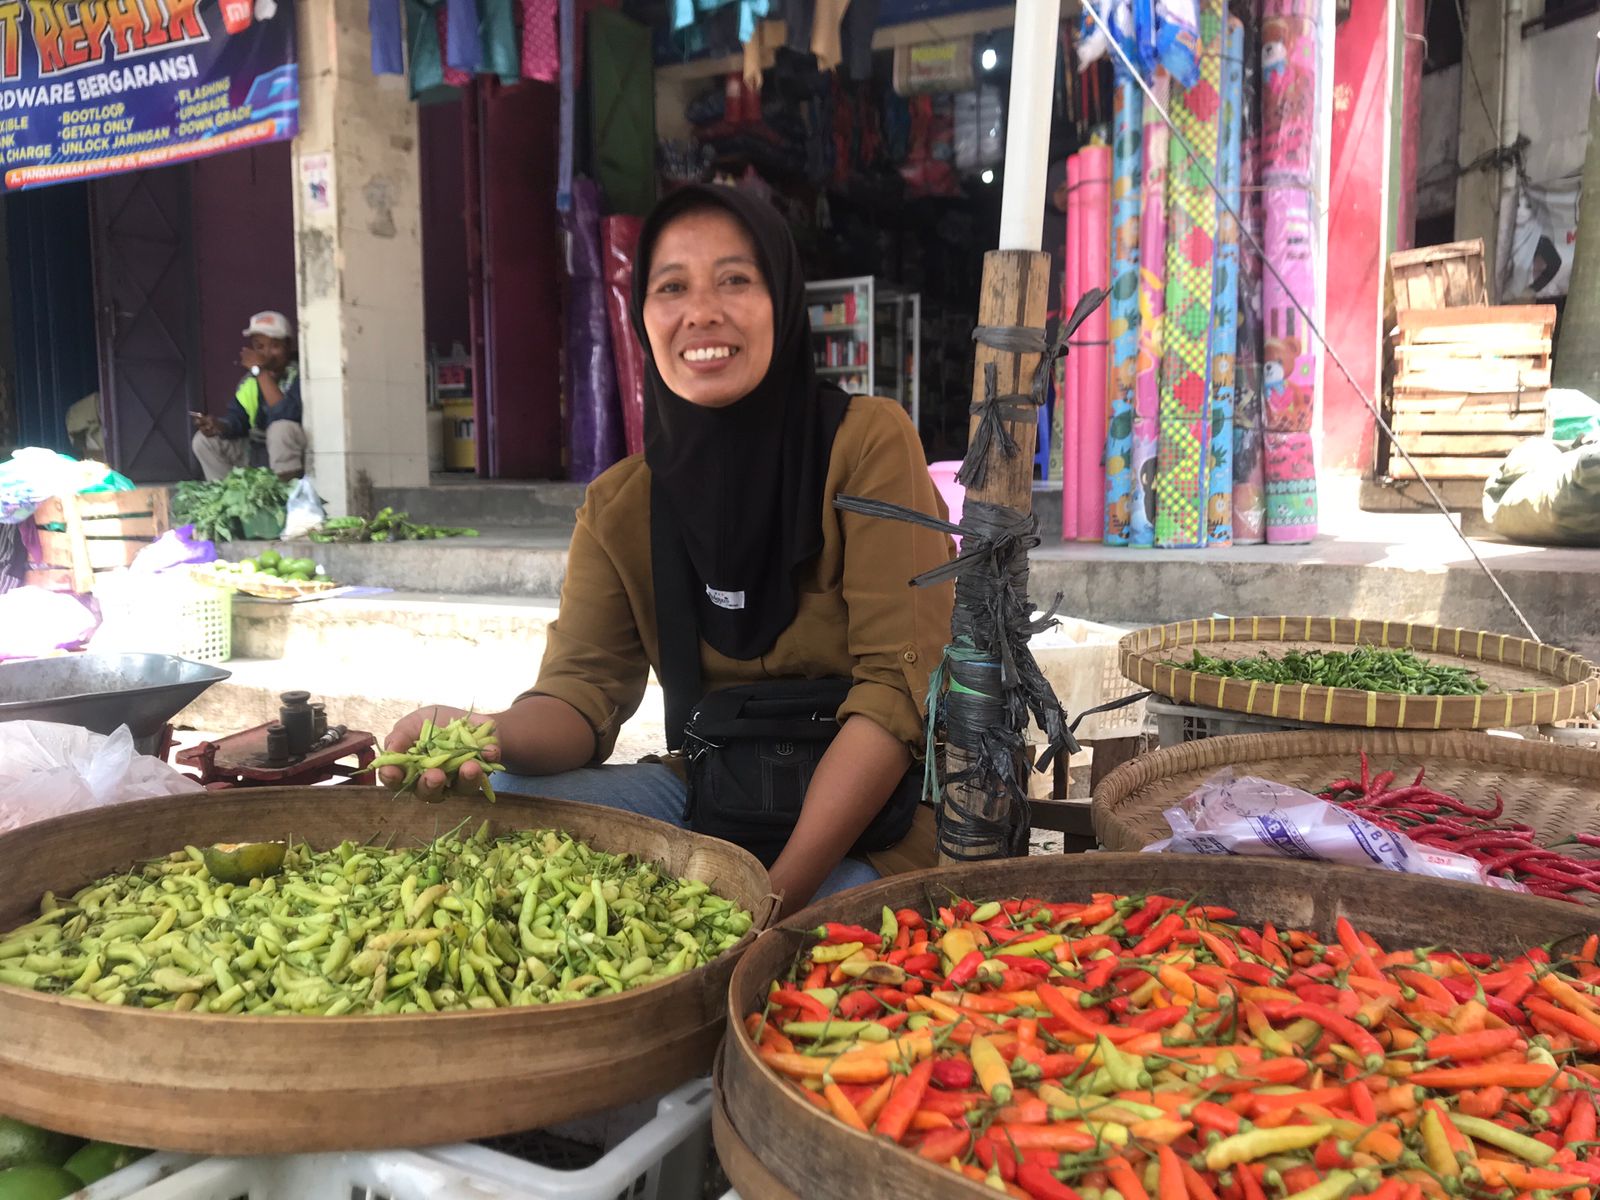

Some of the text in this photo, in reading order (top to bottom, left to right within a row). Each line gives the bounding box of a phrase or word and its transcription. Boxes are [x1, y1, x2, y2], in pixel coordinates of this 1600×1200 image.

[27, 0, 210, 78] REPAIR
[0, 53, 199, 111] DWARE BERGARANSI
[62, 103, 125, 125] BOOTLOOP
[61, 138, 110, 156] UNLOCK
[112, 126, 170, 149] JARINGAN
[62, 117, 134, 140] GETAR ONLY
[7, 144, 52, 163] CHARGE
